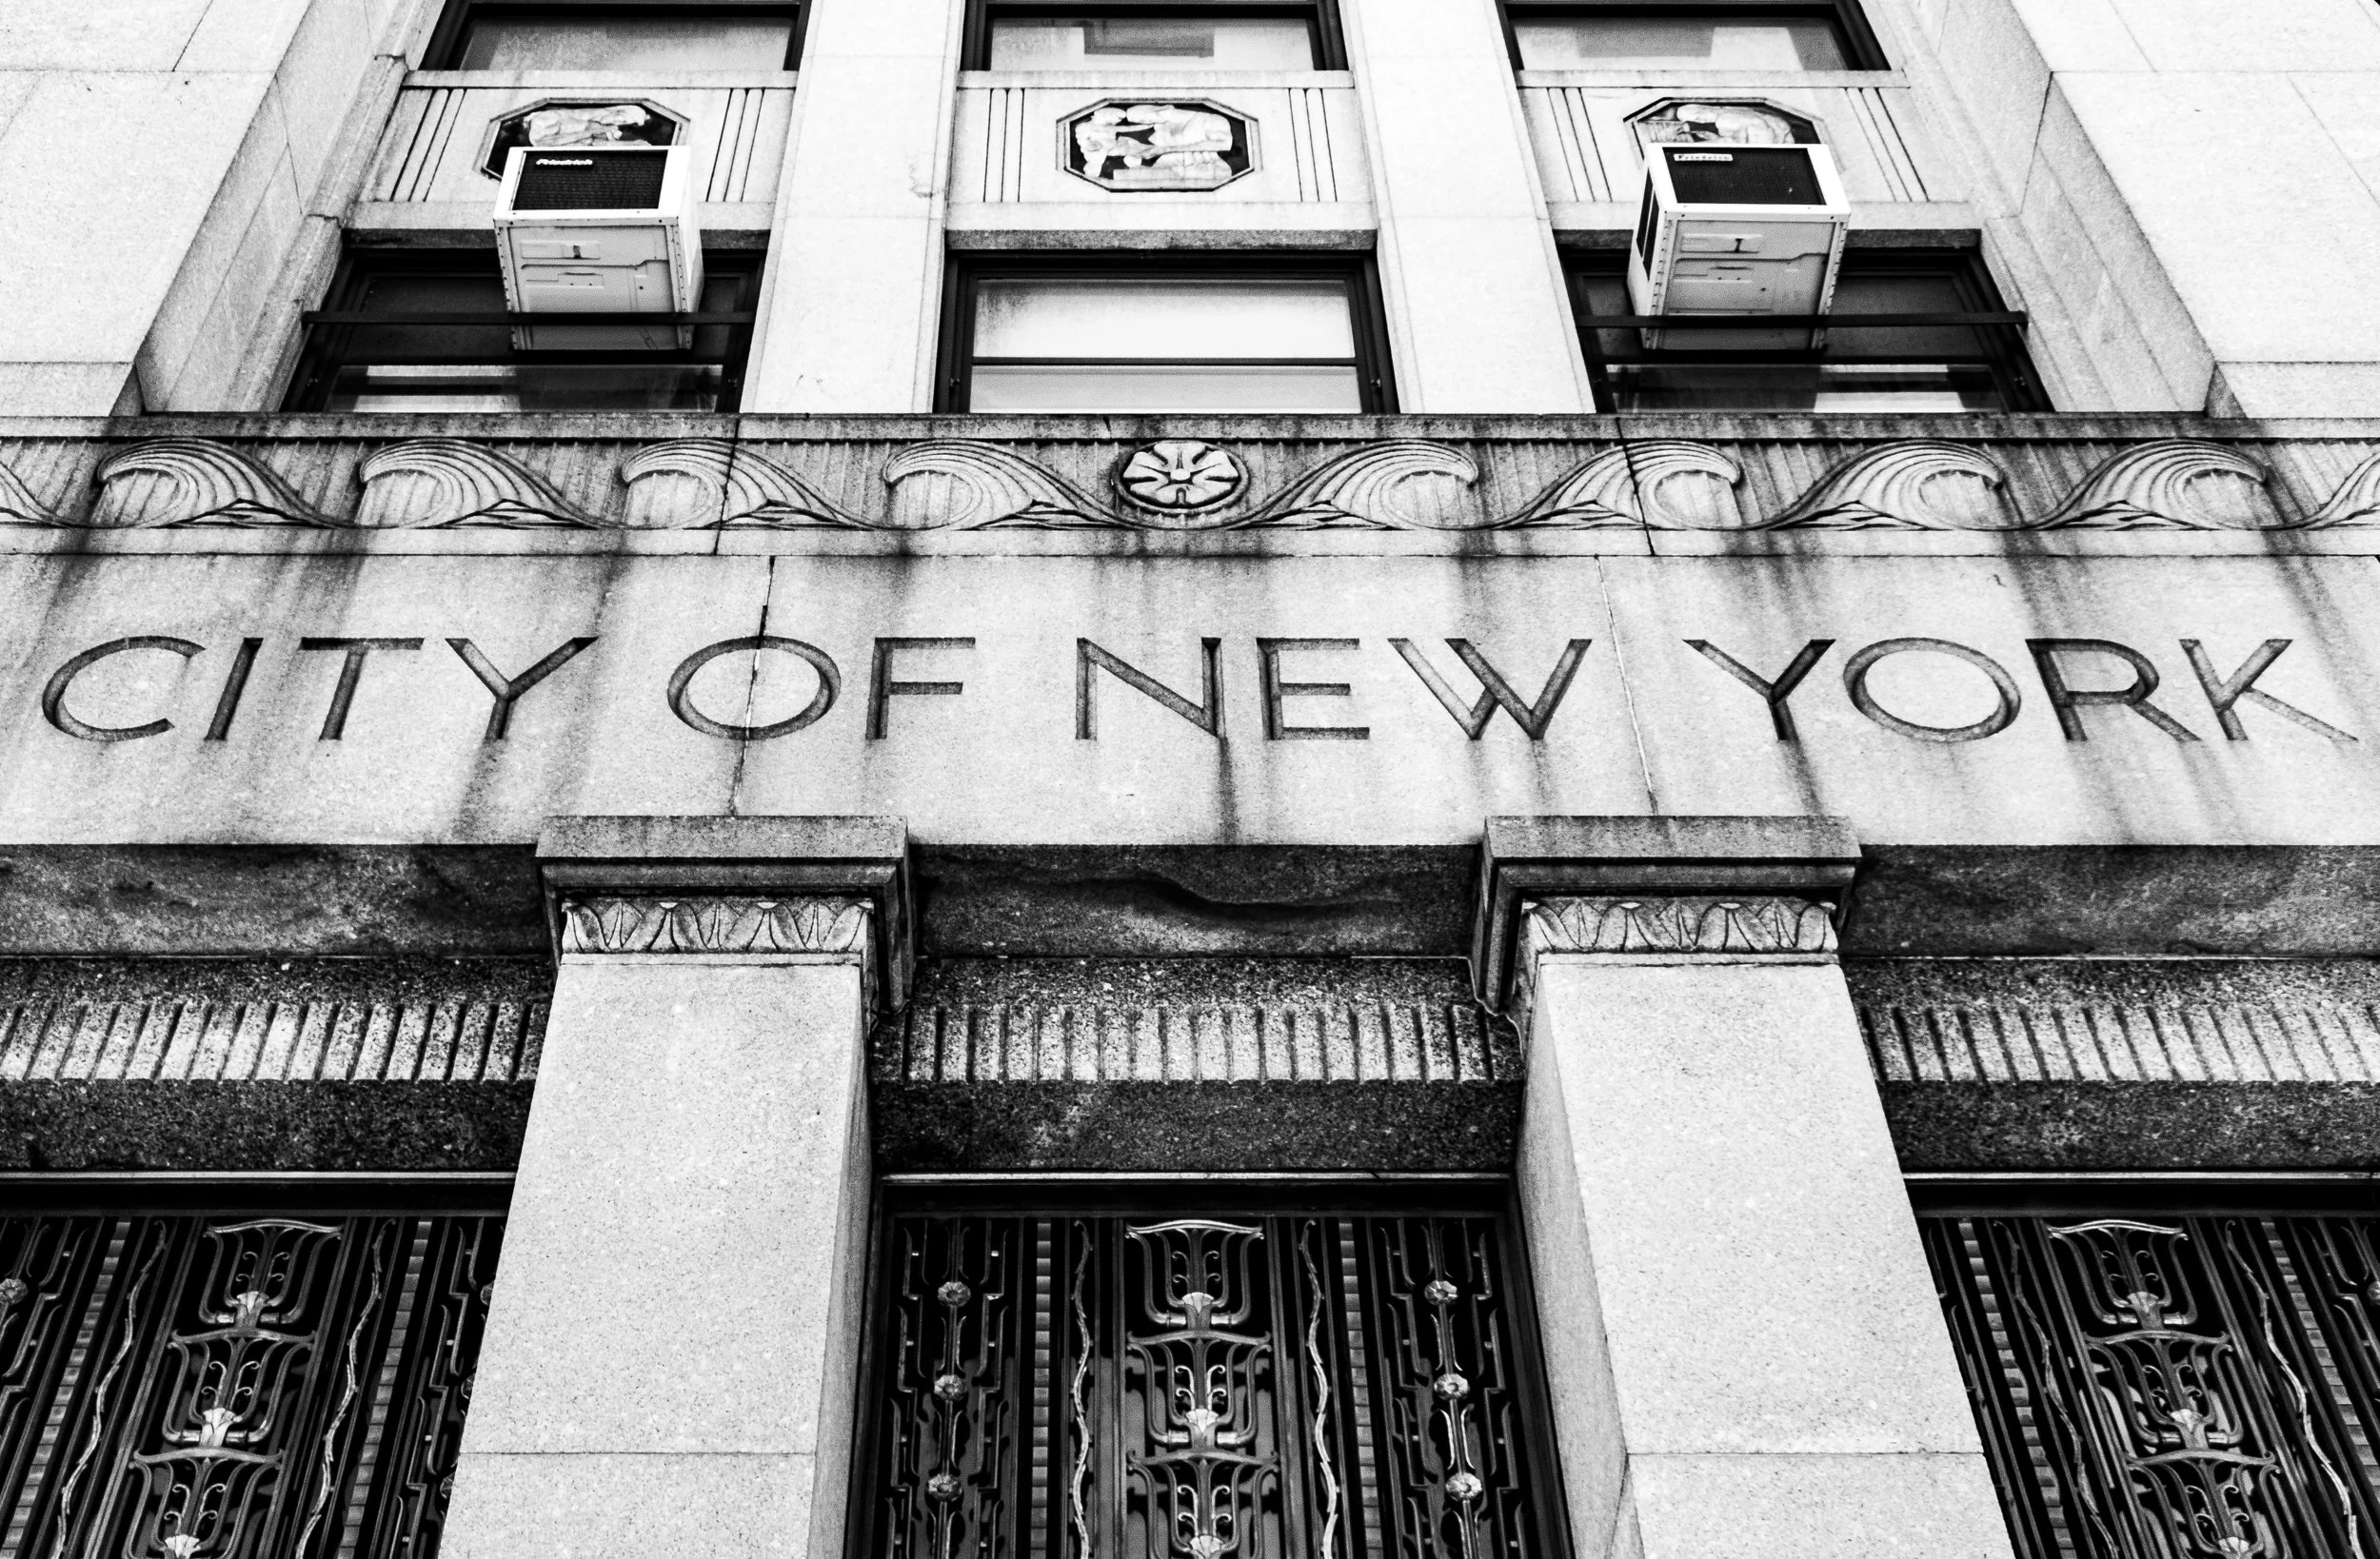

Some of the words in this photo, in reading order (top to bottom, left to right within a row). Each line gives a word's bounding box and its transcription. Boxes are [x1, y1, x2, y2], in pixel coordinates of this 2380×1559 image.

[41, 635, 600, 742] CITY
[666, 635, 975, 740] OF
[1076, 637, 1593, 740] NEW
[1682, 637, 2359, 742] YORK
